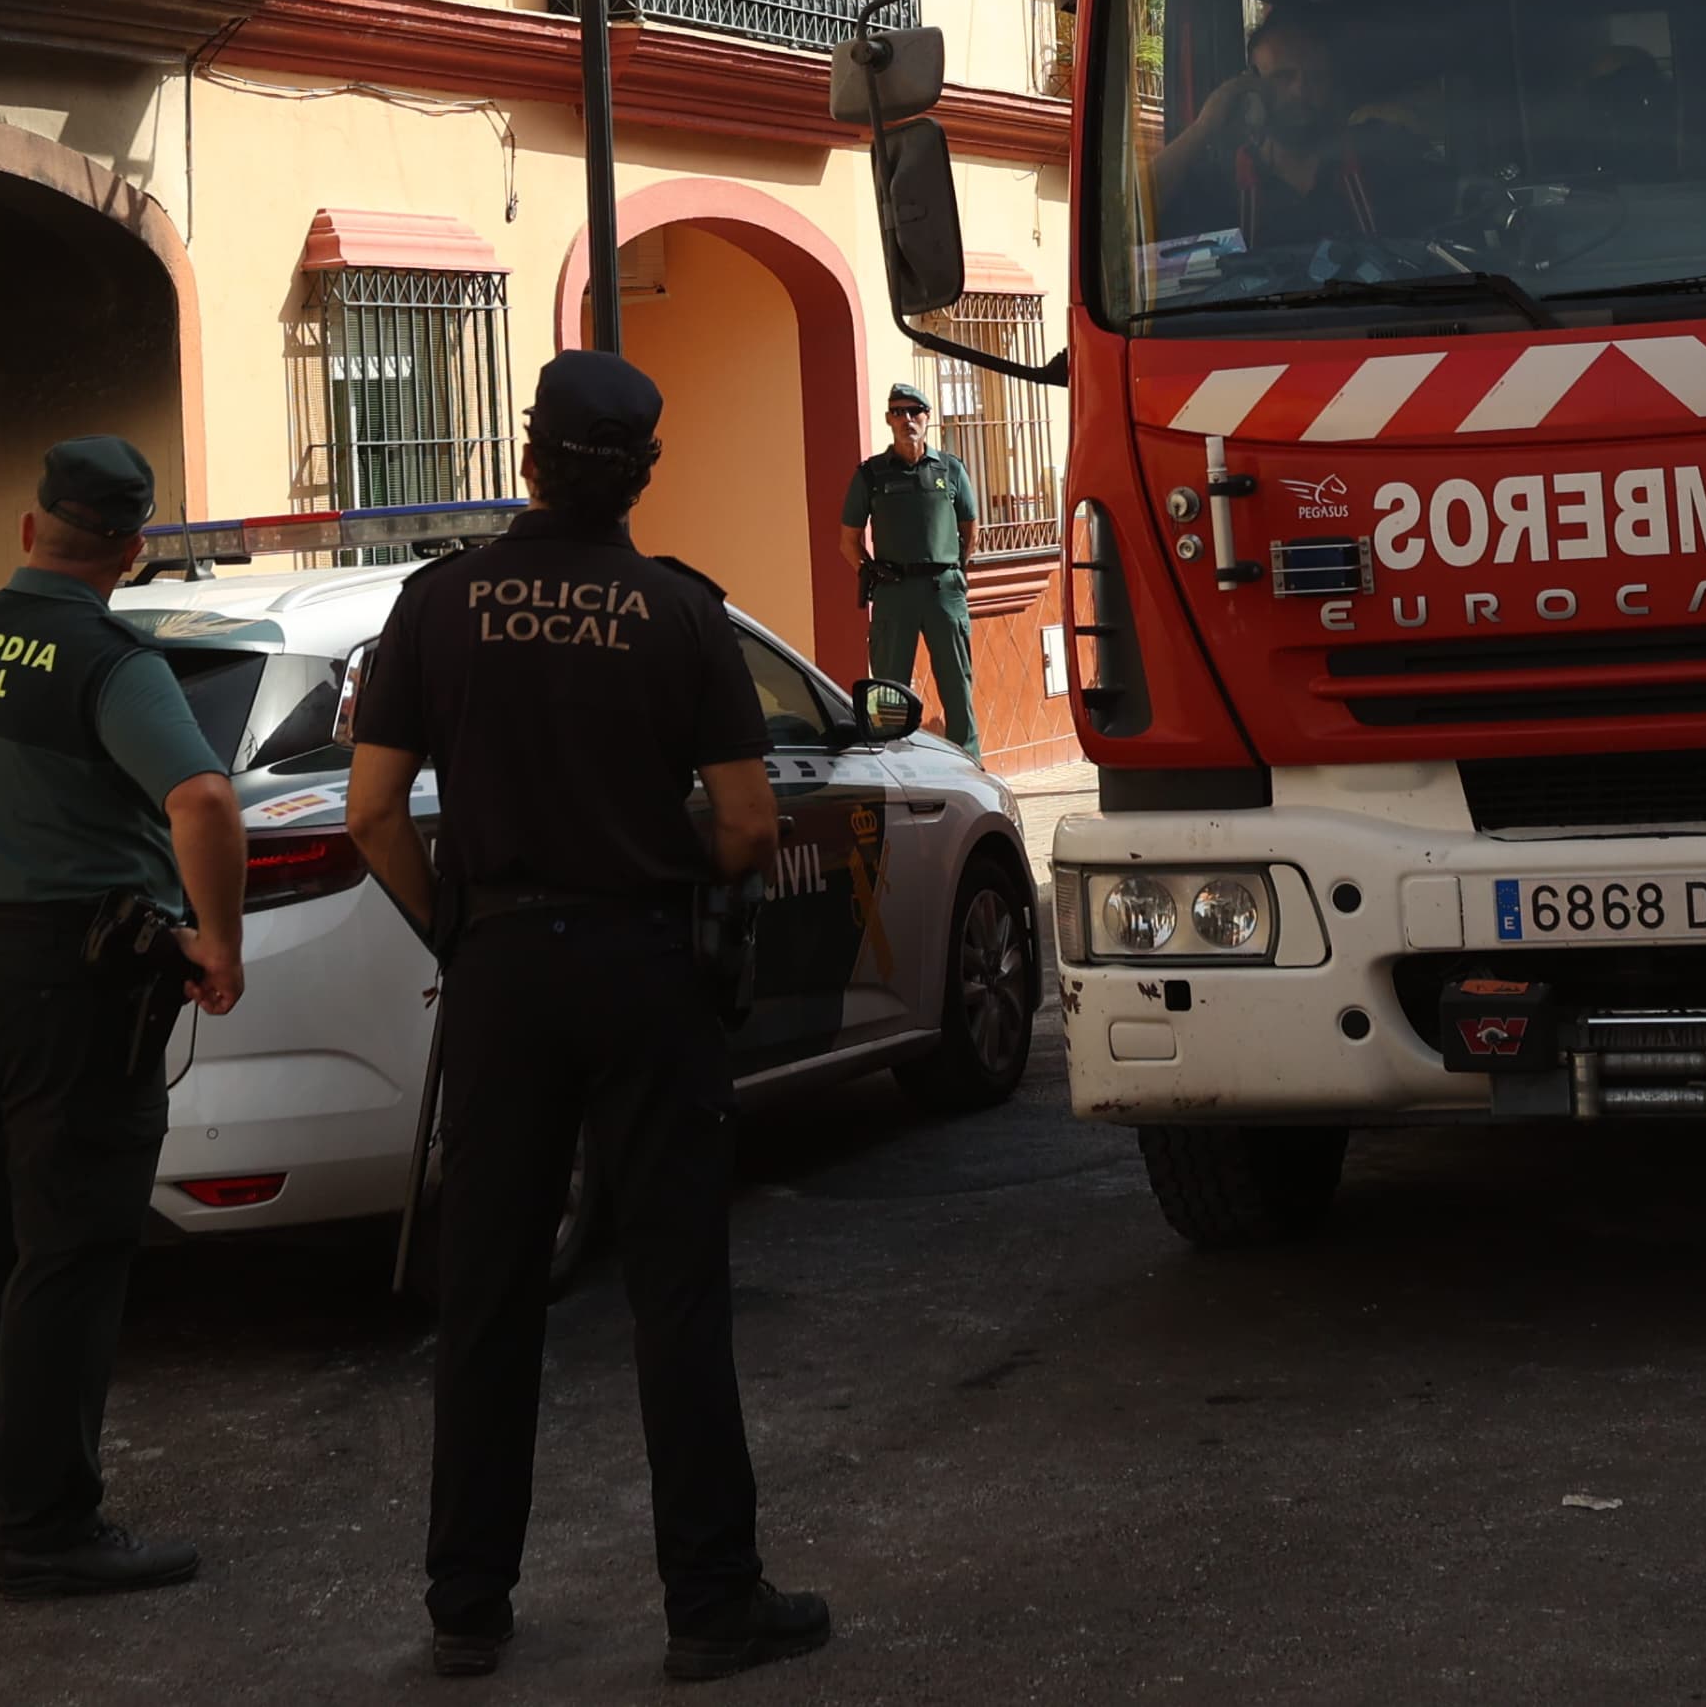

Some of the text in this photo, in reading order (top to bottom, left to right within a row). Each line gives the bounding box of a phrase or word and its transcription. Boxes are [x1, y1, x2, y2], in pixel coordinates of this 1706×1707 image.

[1298, 505, 1349, 519] PEGASUS
[468, 578, 650, 620] POLICÍA
[481, 611, 630, 650] LOCAL
[765, 843, 827, 902] IVIL
[1504, 916, 1515, 930] E
[1531, 882, 1666, 932] 6868
